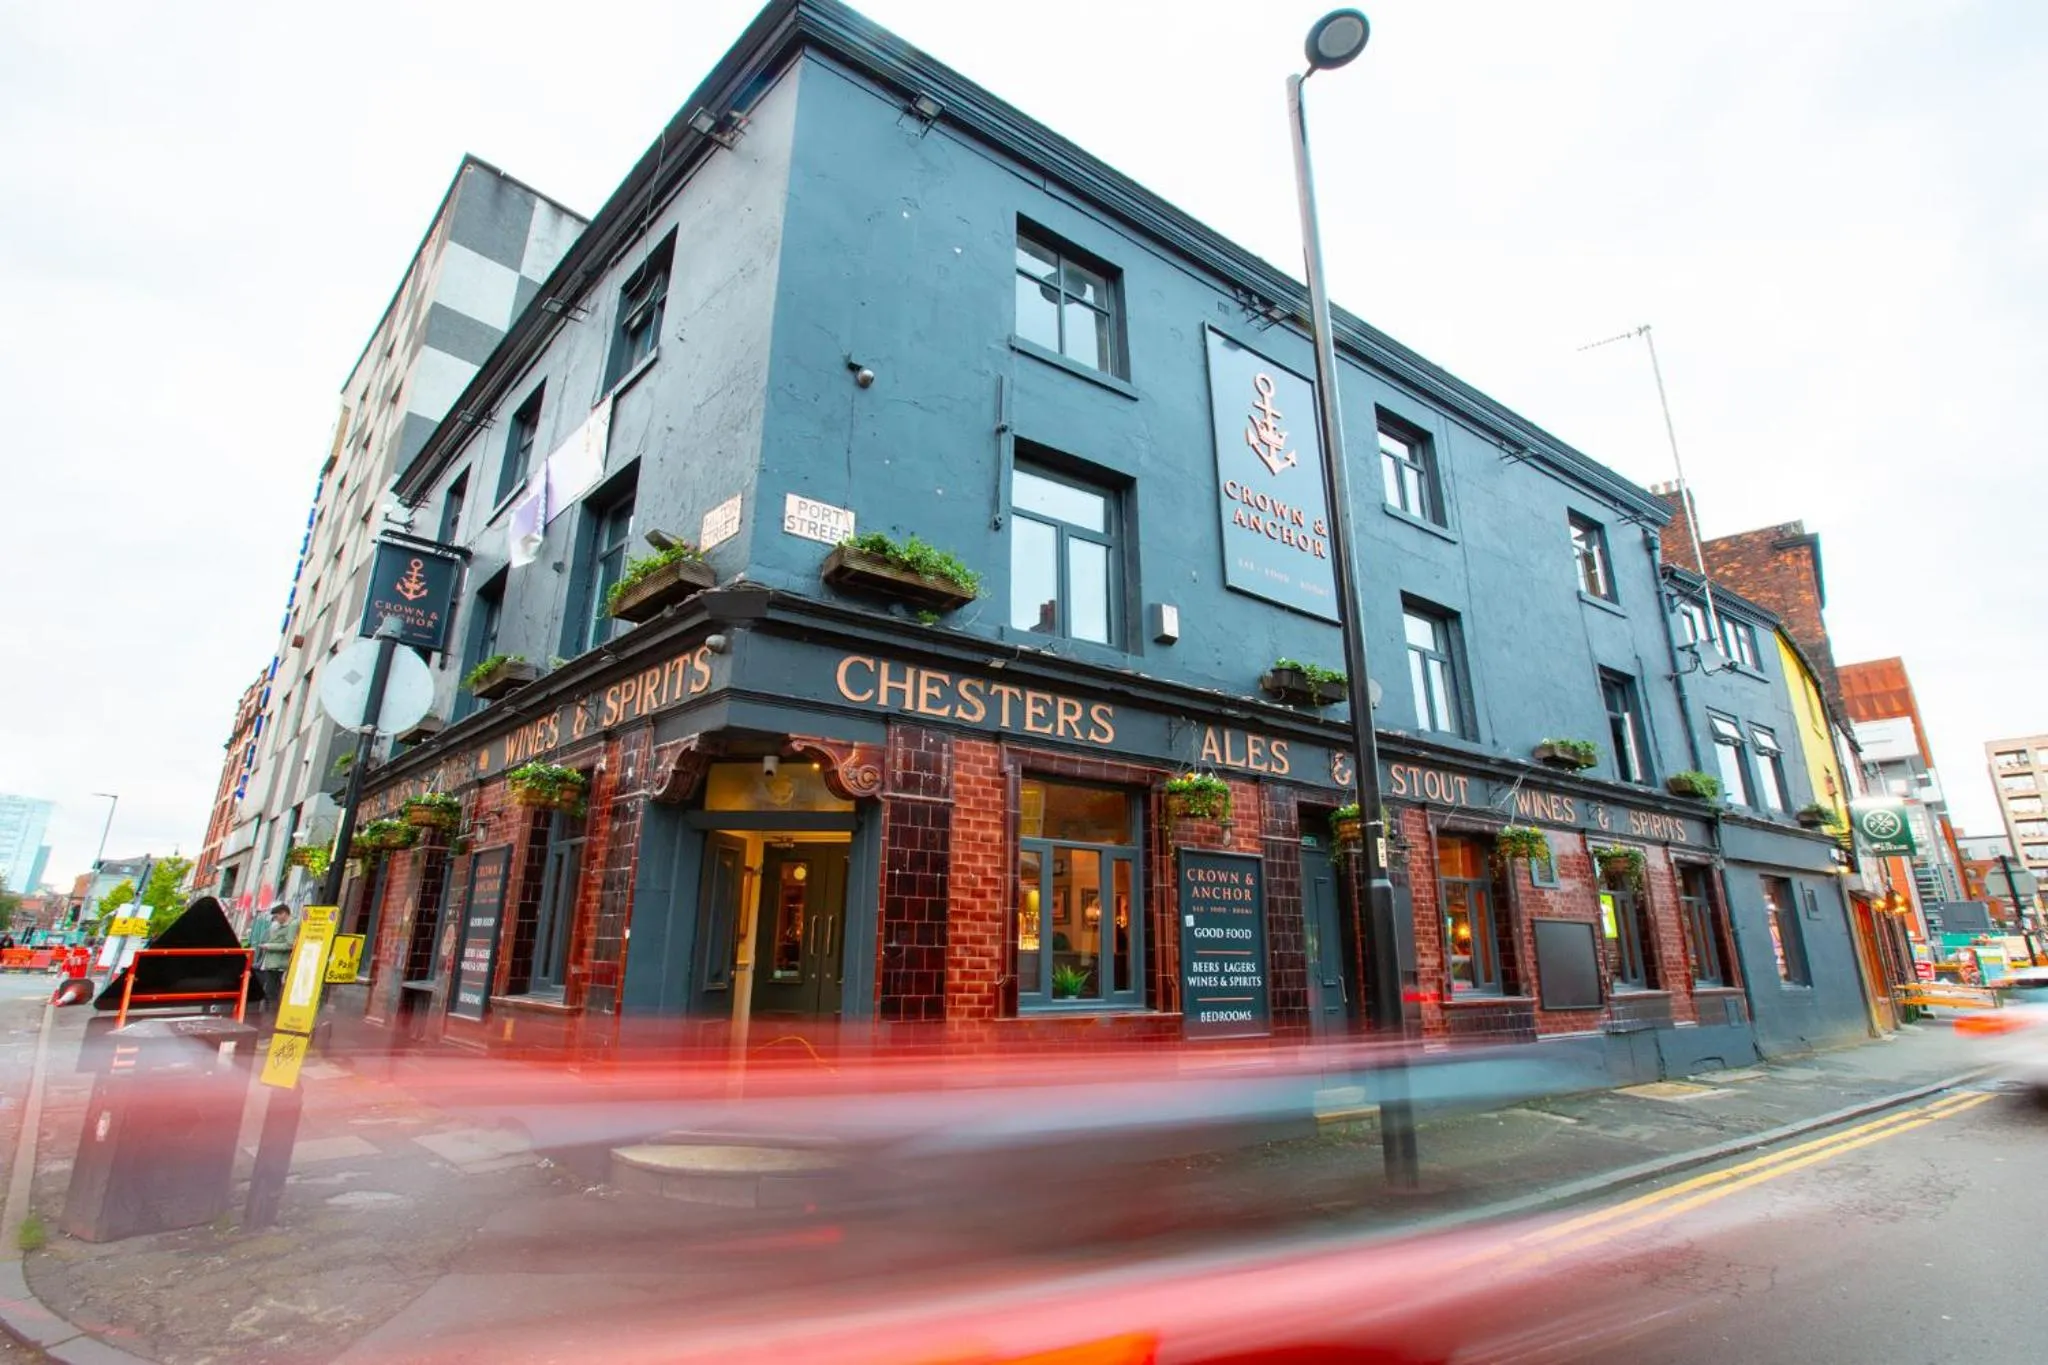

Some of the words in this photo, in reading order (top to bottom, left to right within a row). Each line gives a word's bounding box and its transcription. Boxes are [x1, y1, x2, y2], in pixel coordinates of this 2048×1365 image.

[798, 500, 844, 525] PORT
[1224, 479, 1305, 528] CROWN
[1313, 519, 1327, 538] &
[702, 516, 737, 546] STREET
[1232, 507, 1327, 560] ANCHOR
[374, 600, 425, 617] CROWN
[430, 612, 438, 620] &
[504, 711, 560, 766] WINES
[572, 698, 587, 740] &
[603, 646, 713, 728] SPIRITS
[835, 655, 1116, 745] CHESTERS
[1201, 725, 1291, 776] ALES
[1331, 752, 1352, 786] &
[1391, 763, 1469, 806] STOUT
[1514, 789, 1577, 823] WINES
[1597, 800, 1610, 830] &
[1629, 809, 1687, 843] SPIRITS
[1187, 868, 1239, 885] CROWN
[1245, 872, 1255, 886] &
[1191, 886, 1252, 901] ANCHOR
[1194, 928, 1225, 939] GOOD
[1226, 928, 1252, 939] FOOD
[1192, 962, 1220, 973] BEERS
[1224, 962, 1256, 973] LAGERS
[1187, 976, 1218, 987] WINES
[1220, 976, 1228, 987] &
[1229, 976, 1262, 987] SPIRITS
[1201, 1010, 1252, 1023] BEDROOMS
